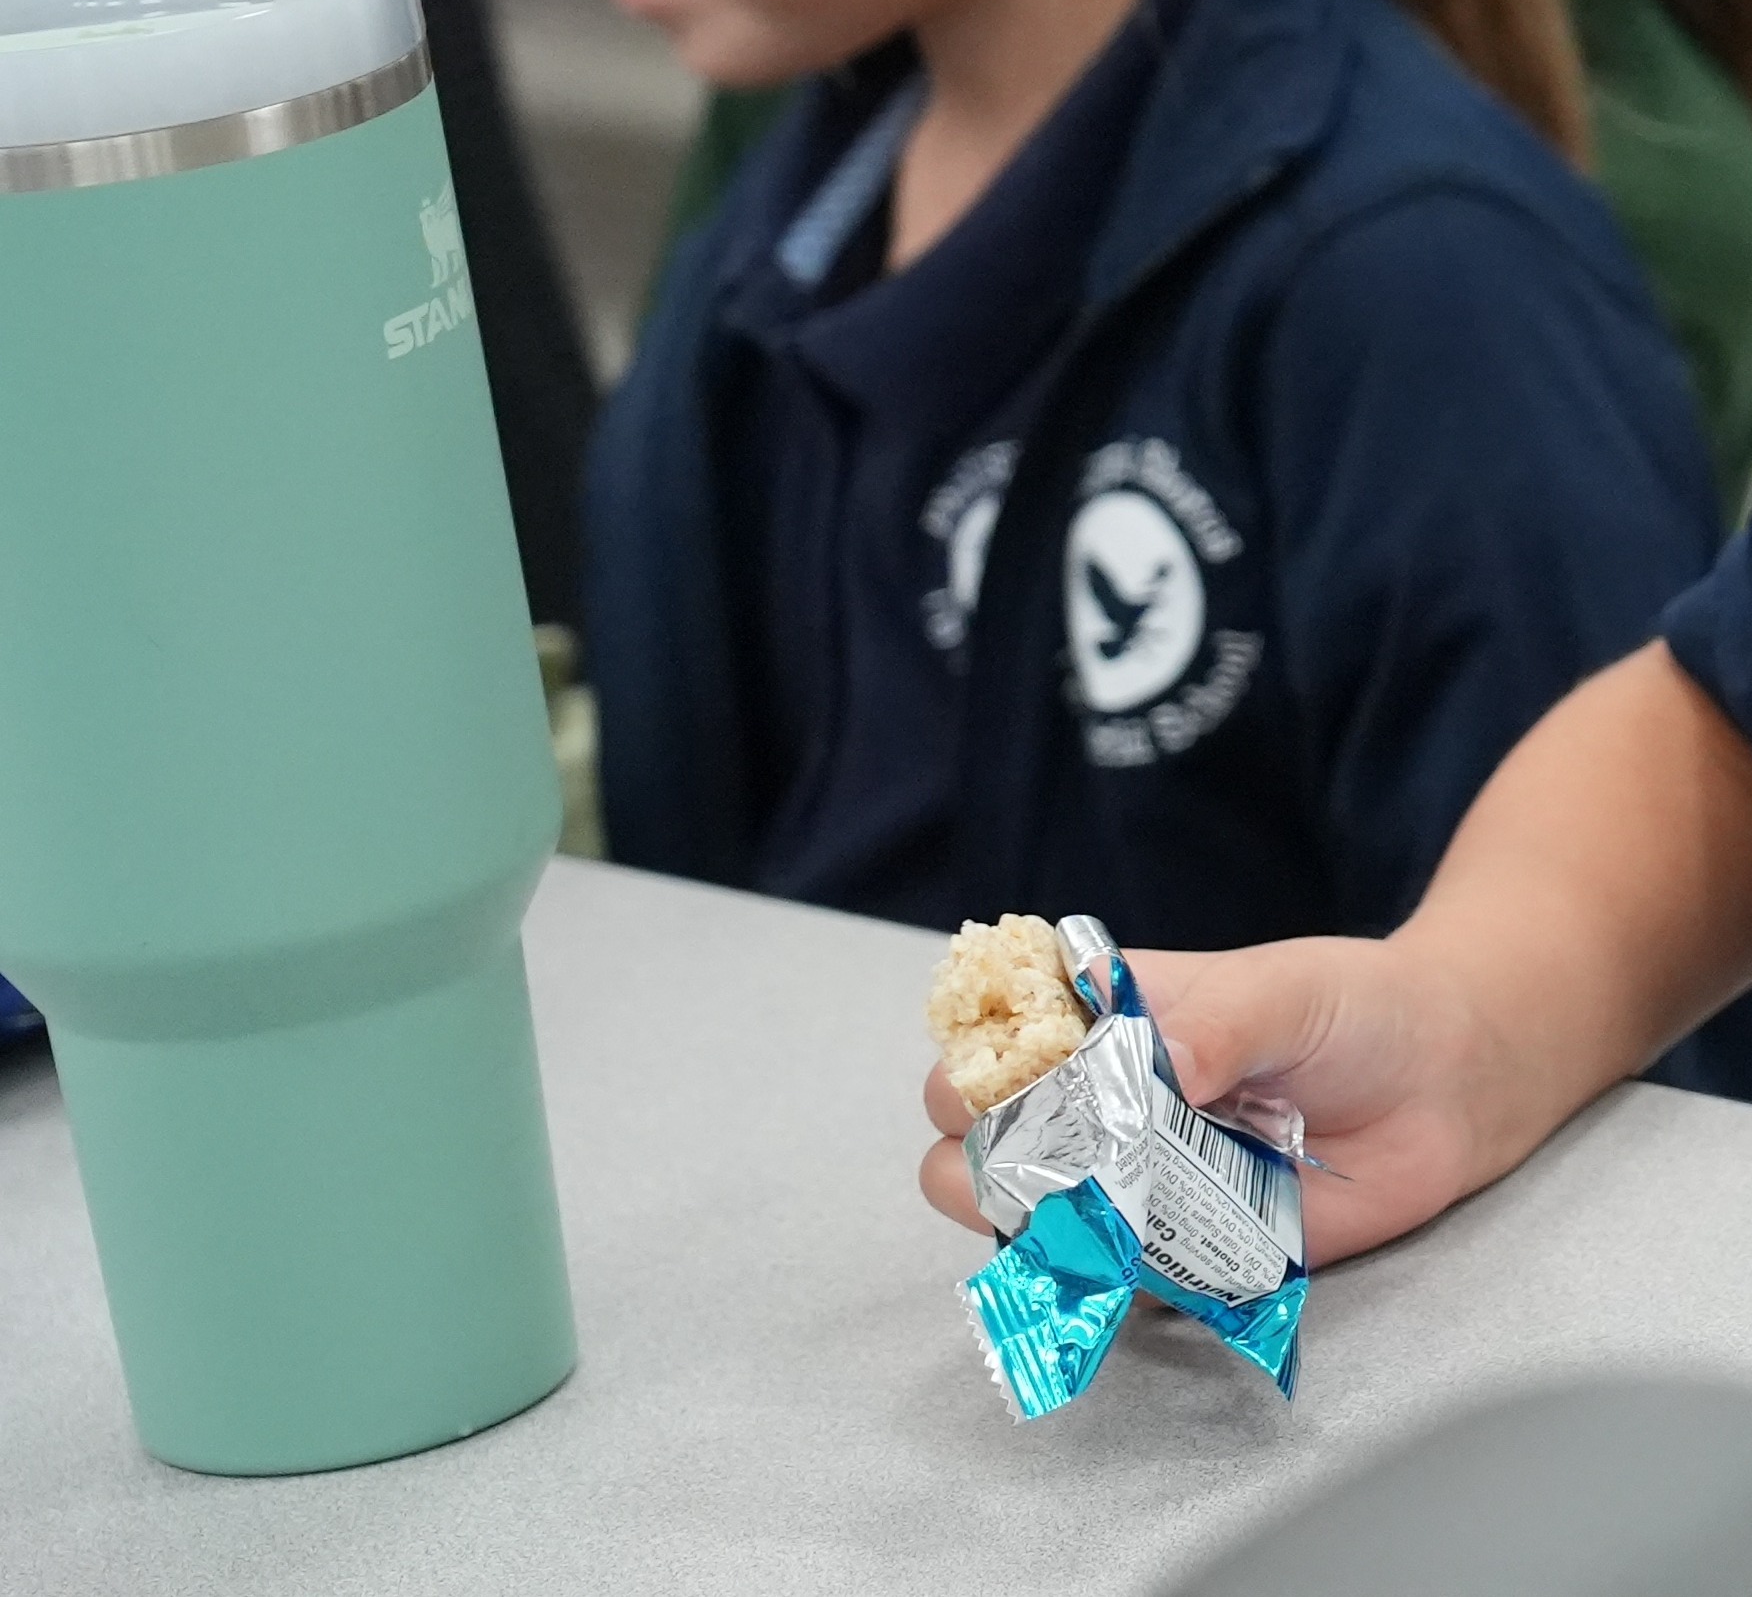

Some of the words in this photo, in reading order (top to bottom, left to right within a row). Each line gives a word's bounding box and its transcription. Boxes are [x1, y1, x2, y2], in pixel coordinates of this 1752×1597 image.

[1175, 1195, 1190, 1213] 11g
[1200, 1198, 1218, 1217] Iron
[1179, 1217, 1199, 1238] 0mg
[1191, 1210, 1221, 1238] Sugars
[1200, 1235, 1240, 1272] Cholest.
[1219, 1234, 1241, 1256] Total
[1143, 1241, 1242, 1302] Nutrition
[1211, 1264, 1228, 1278] per
